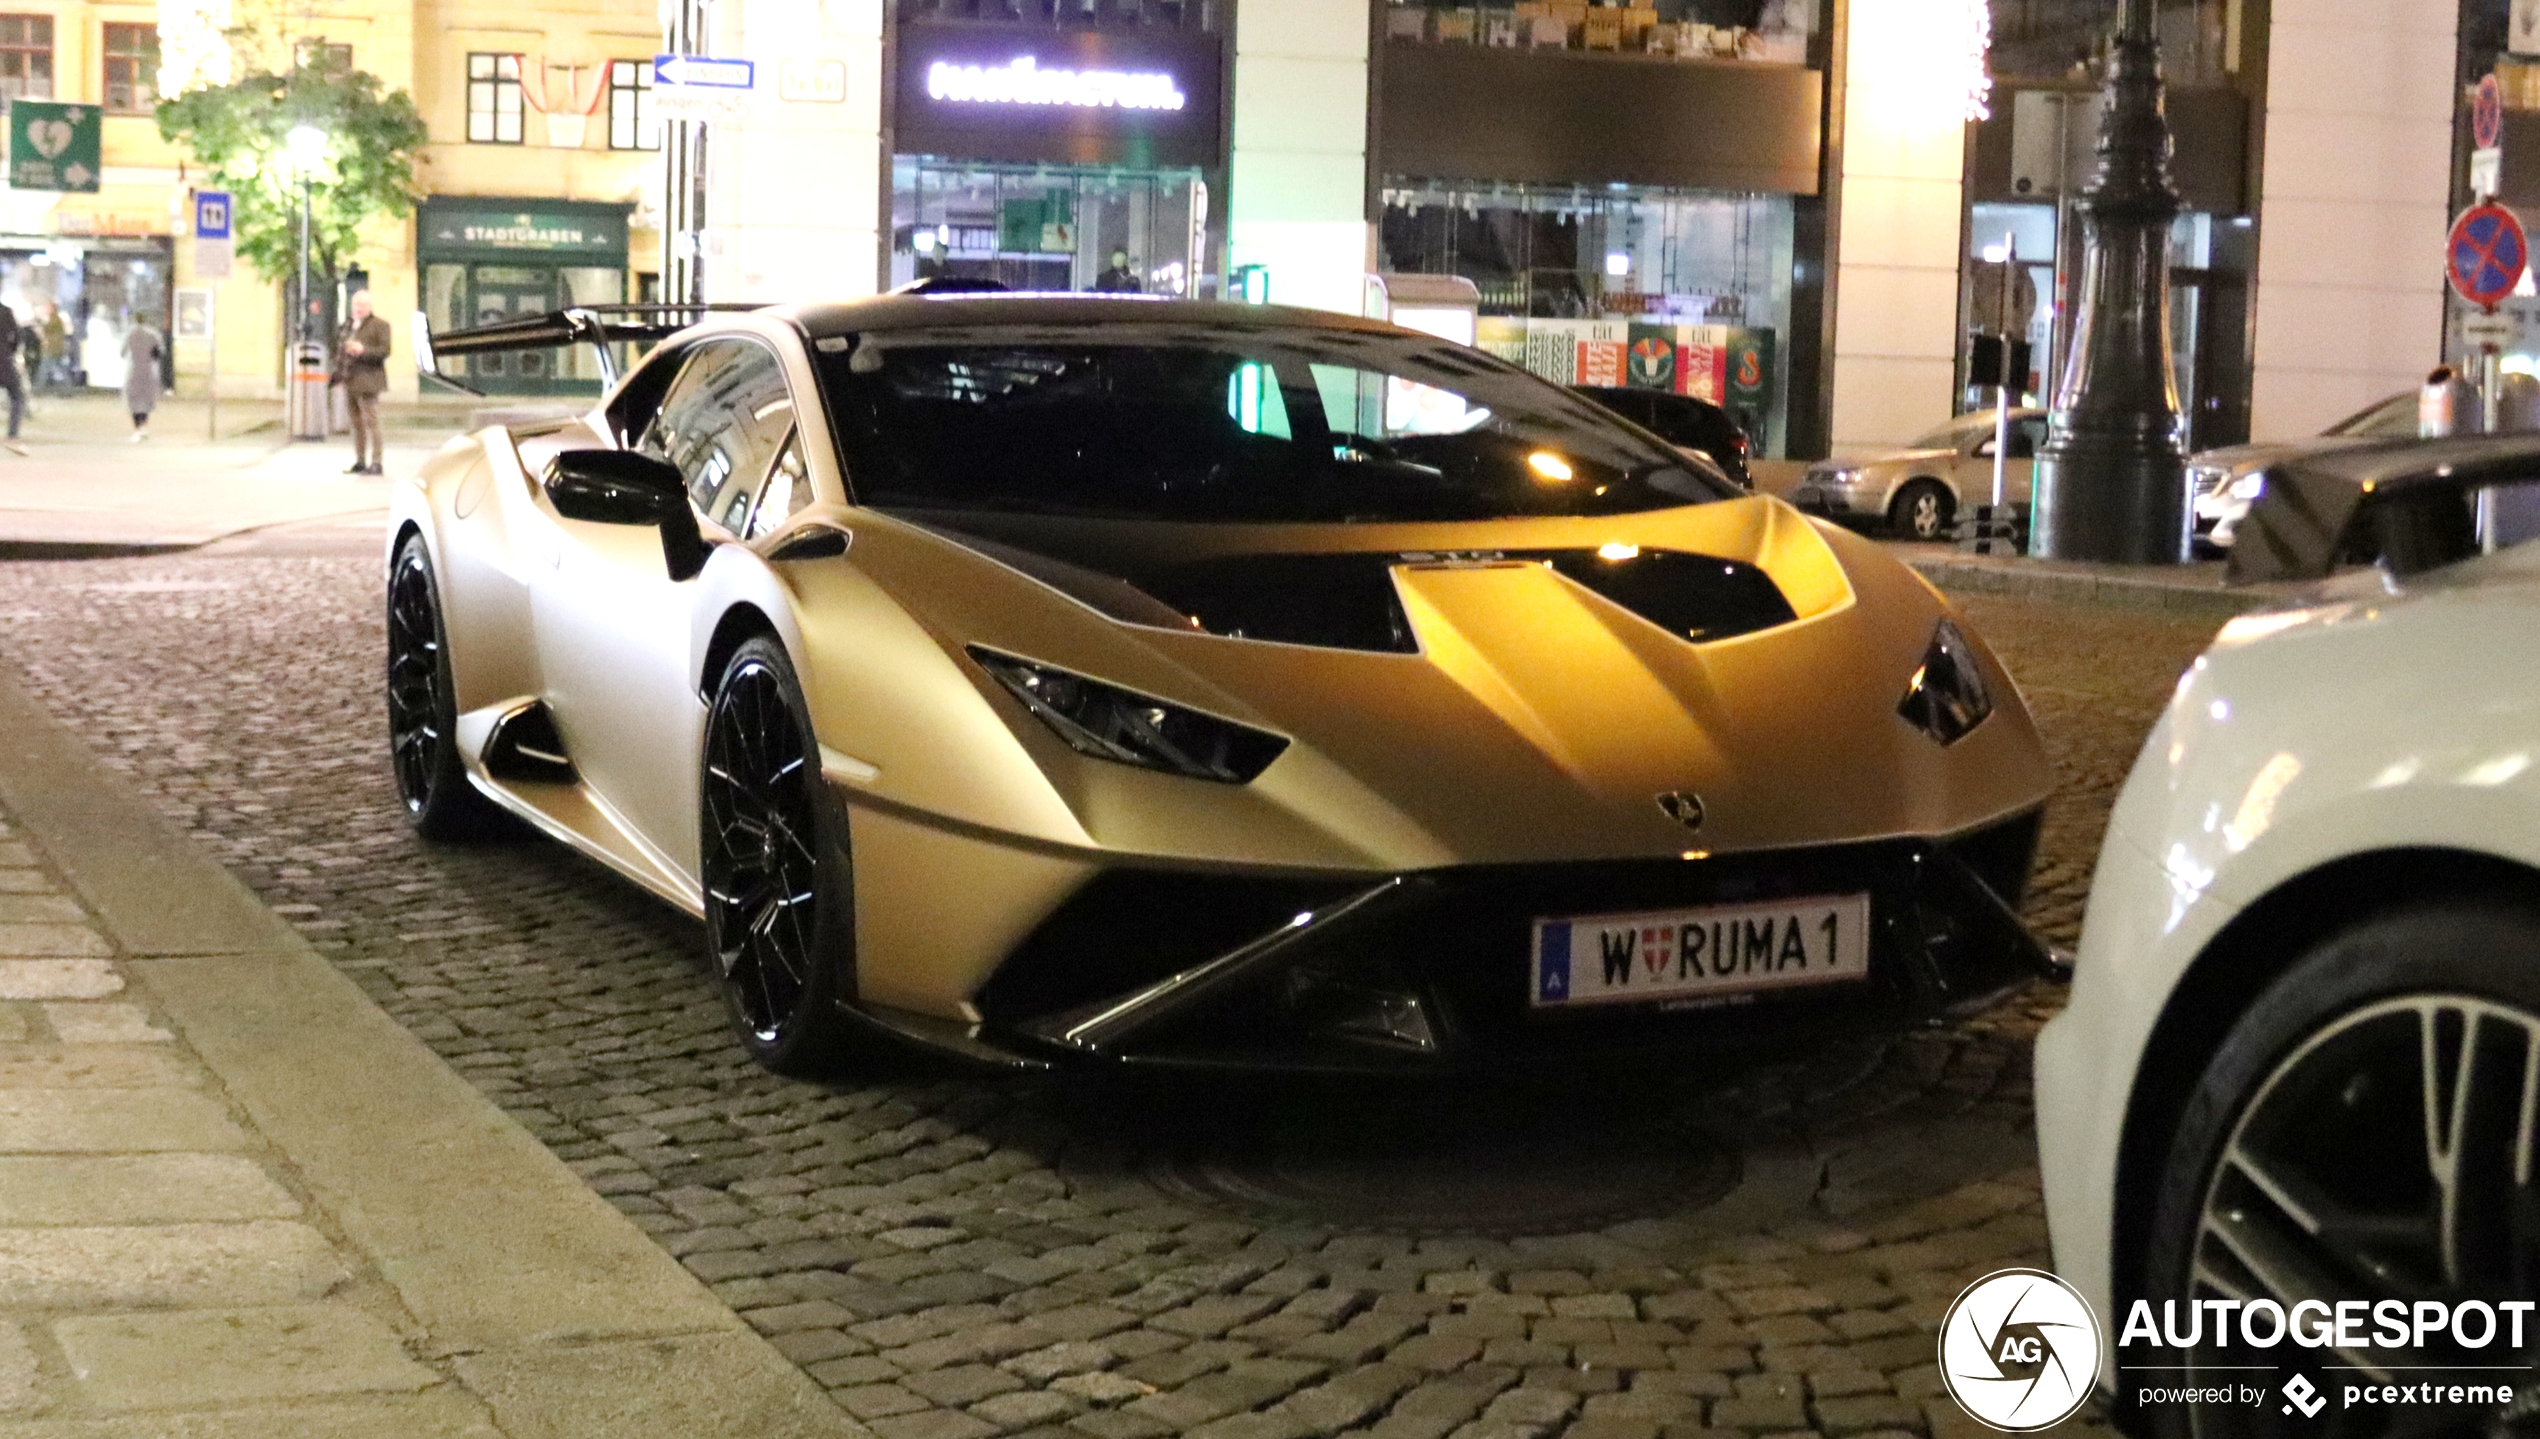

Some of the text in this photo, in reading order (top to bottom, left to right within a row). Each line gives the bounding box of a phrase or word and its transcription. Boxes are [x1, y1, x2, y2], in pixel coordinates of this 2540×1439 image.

[686, 66, 744, 81] EINBAHN
[464, 227, 584, 243] STADTGRABEN
[1600, 911, 1838, 987] W RUMA 1
[1547, 971, 1562, 990] A
